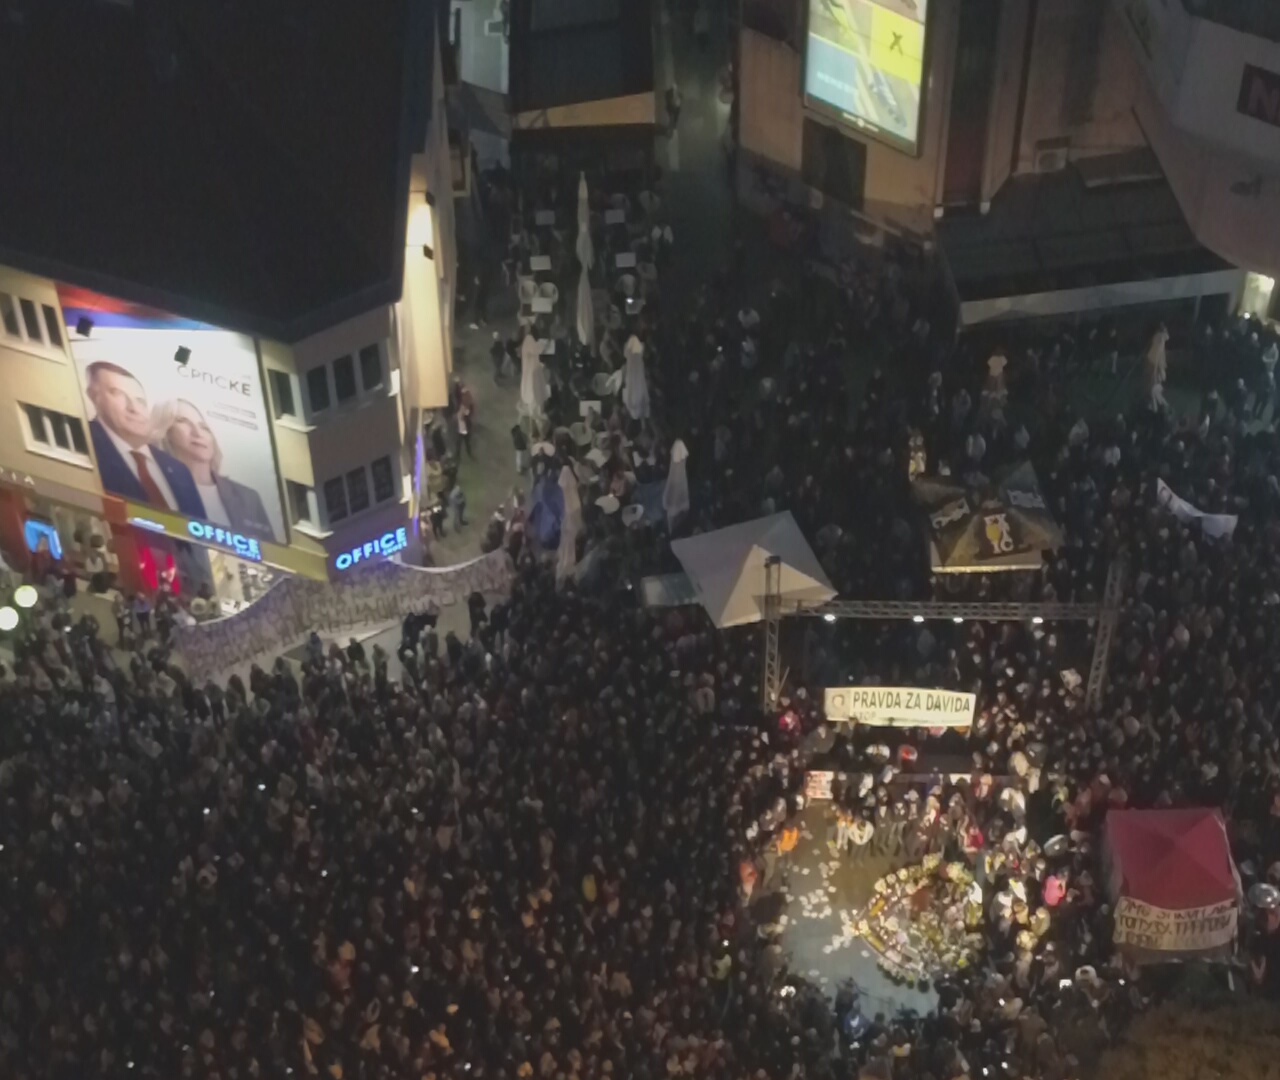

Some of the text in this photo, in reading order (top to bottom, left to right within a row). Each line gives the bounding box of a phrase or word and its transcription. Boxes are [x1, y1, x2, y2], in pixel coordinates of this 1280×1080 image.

[187, 520, 259, 554] OFFICE
[335, 527, 407, 570] OFFICE
[853, 691, 971, 713] PRAVDA ZA DAVIDA
